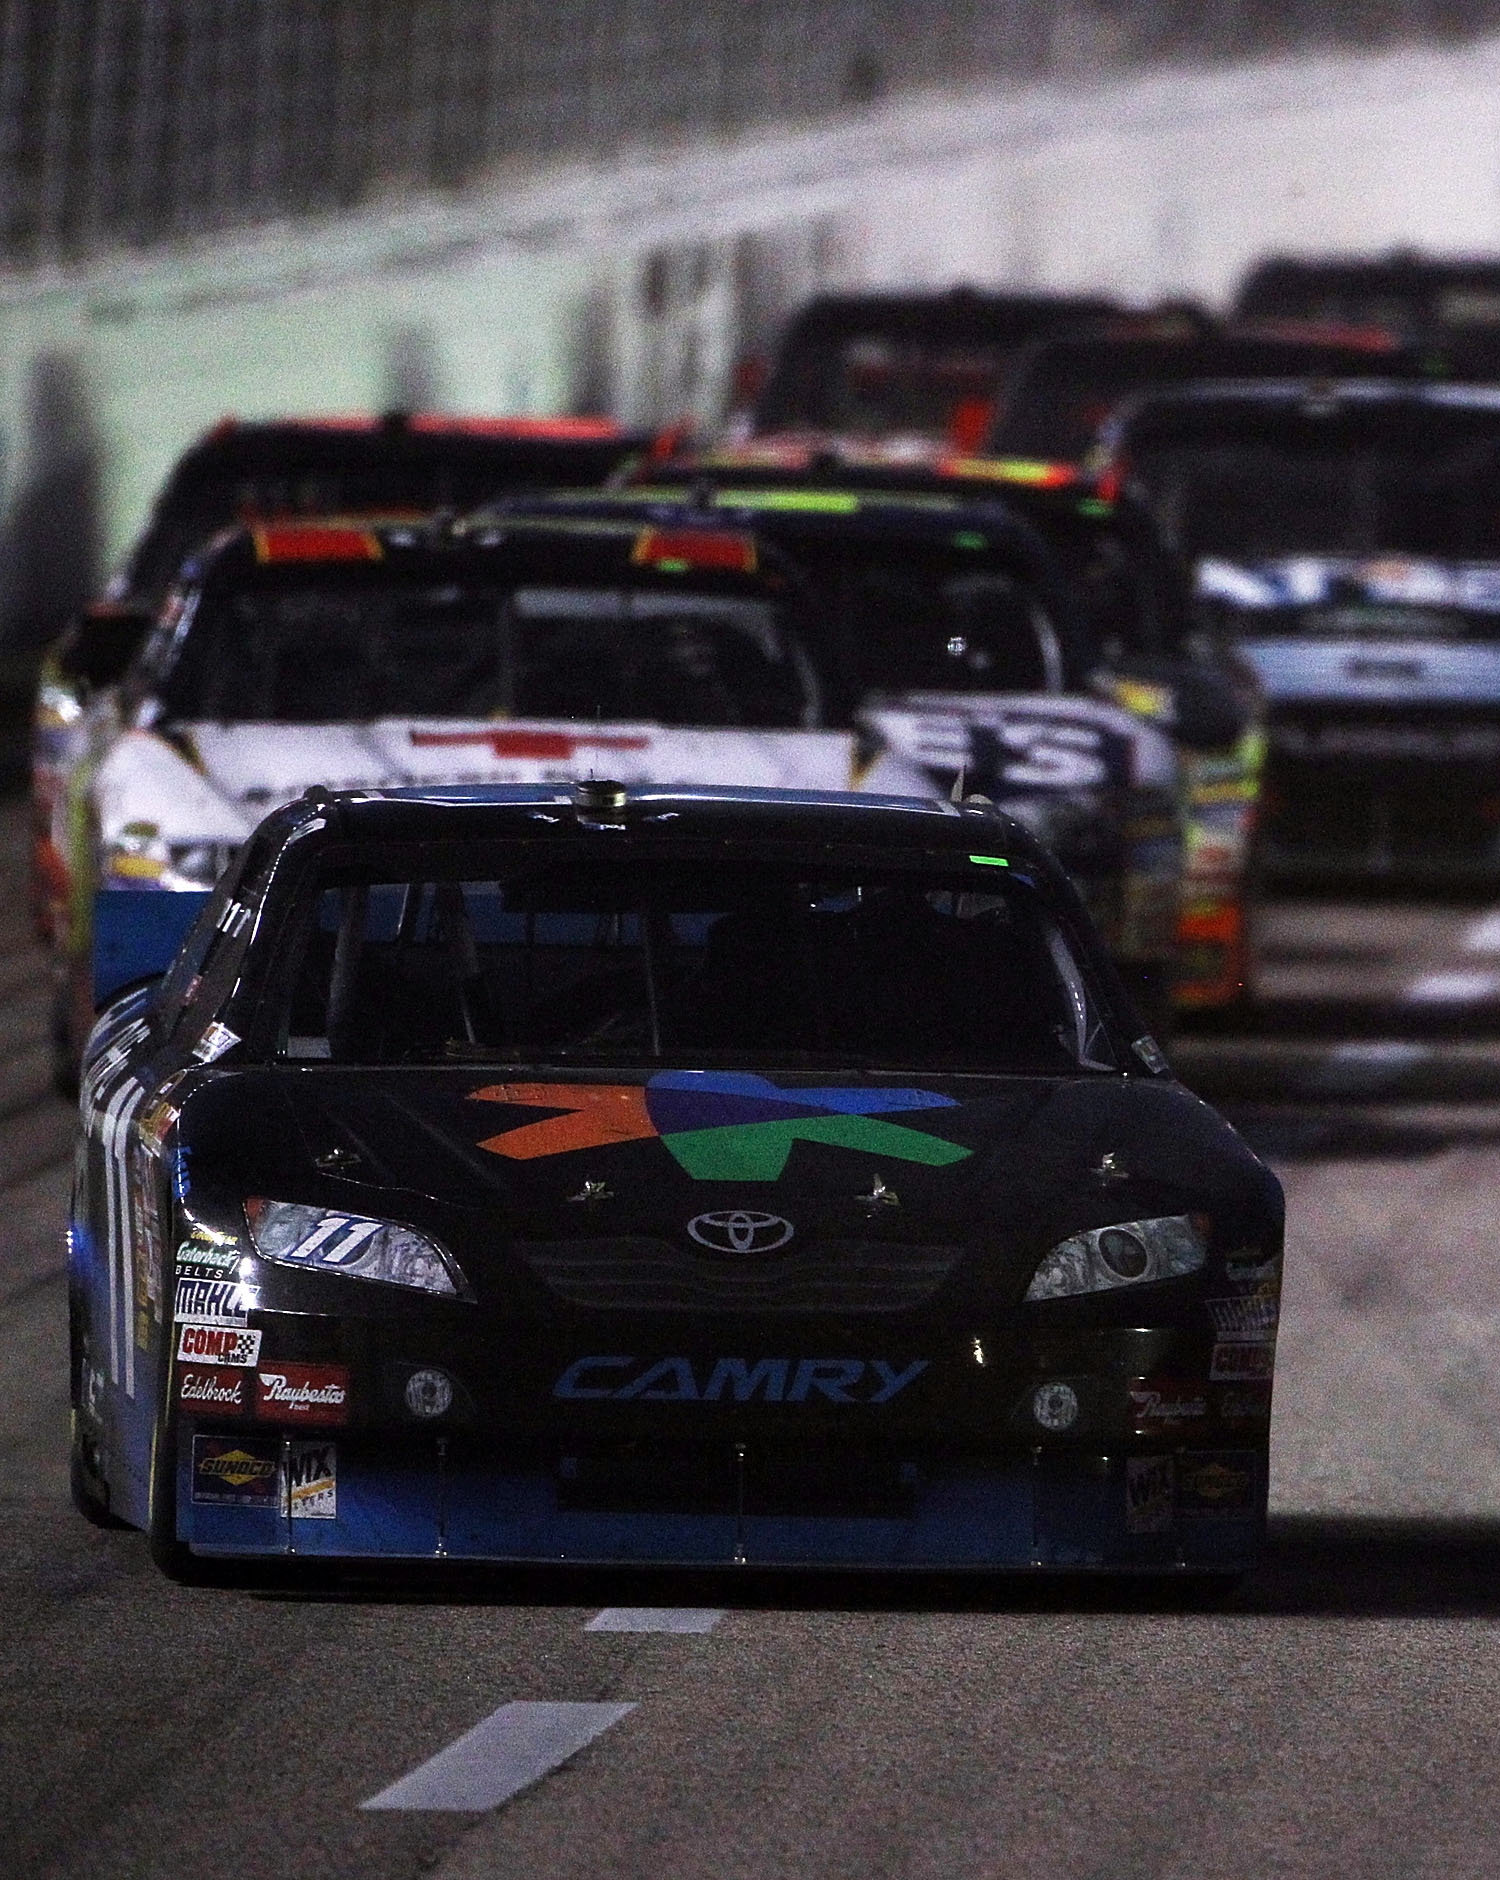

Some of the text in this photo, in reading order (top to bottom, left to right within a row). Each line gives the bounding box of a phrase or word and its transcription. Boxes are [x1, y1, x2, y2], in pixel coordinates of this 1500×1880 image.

[290, 1217, 384, 1262] 11
[175, 1265, 224, 1279] BELTS
[183, 1328, 239, 1355] COMP
[218, 1353, 248, 1364] CAMS
[181, 1373, 346, 1405] Edelbrock Raybestos
[552, 1356, 931, 1401] CAMRY
[202, 1460, 273, 1476] SUNOCO
